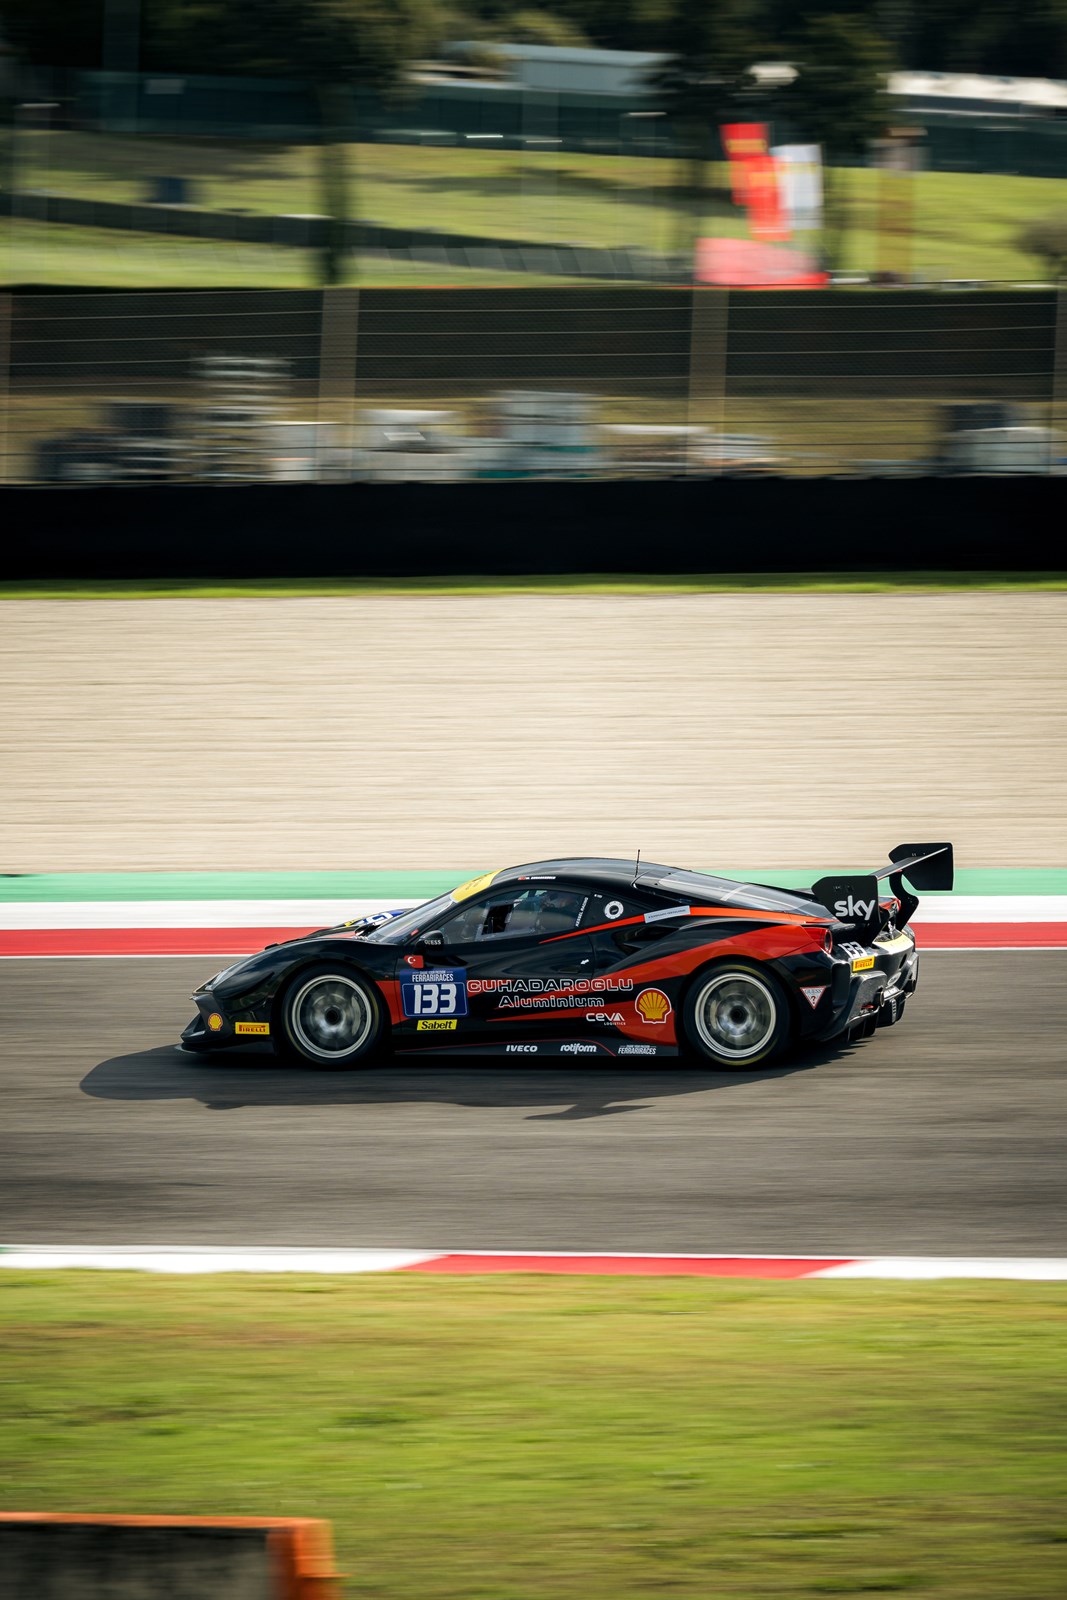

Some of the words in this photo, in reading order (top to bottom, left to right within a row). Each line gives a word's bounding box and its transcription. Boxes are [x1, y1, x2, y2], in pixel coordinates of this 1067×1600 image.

[834, 895, 875, 921] sky
[854, 958, 873, 969] PIRELLI
[413, 983, 457, 1015] 133
[498, 995, 605, 1008] Aluminium
[238, 1024, 266, 1033] PIRELLI
[421, 1020, 453, 1030] Sabelt
[505, 1044, 538, 1053] IVECO
[560, 1043, 597, 1055] rotiform
